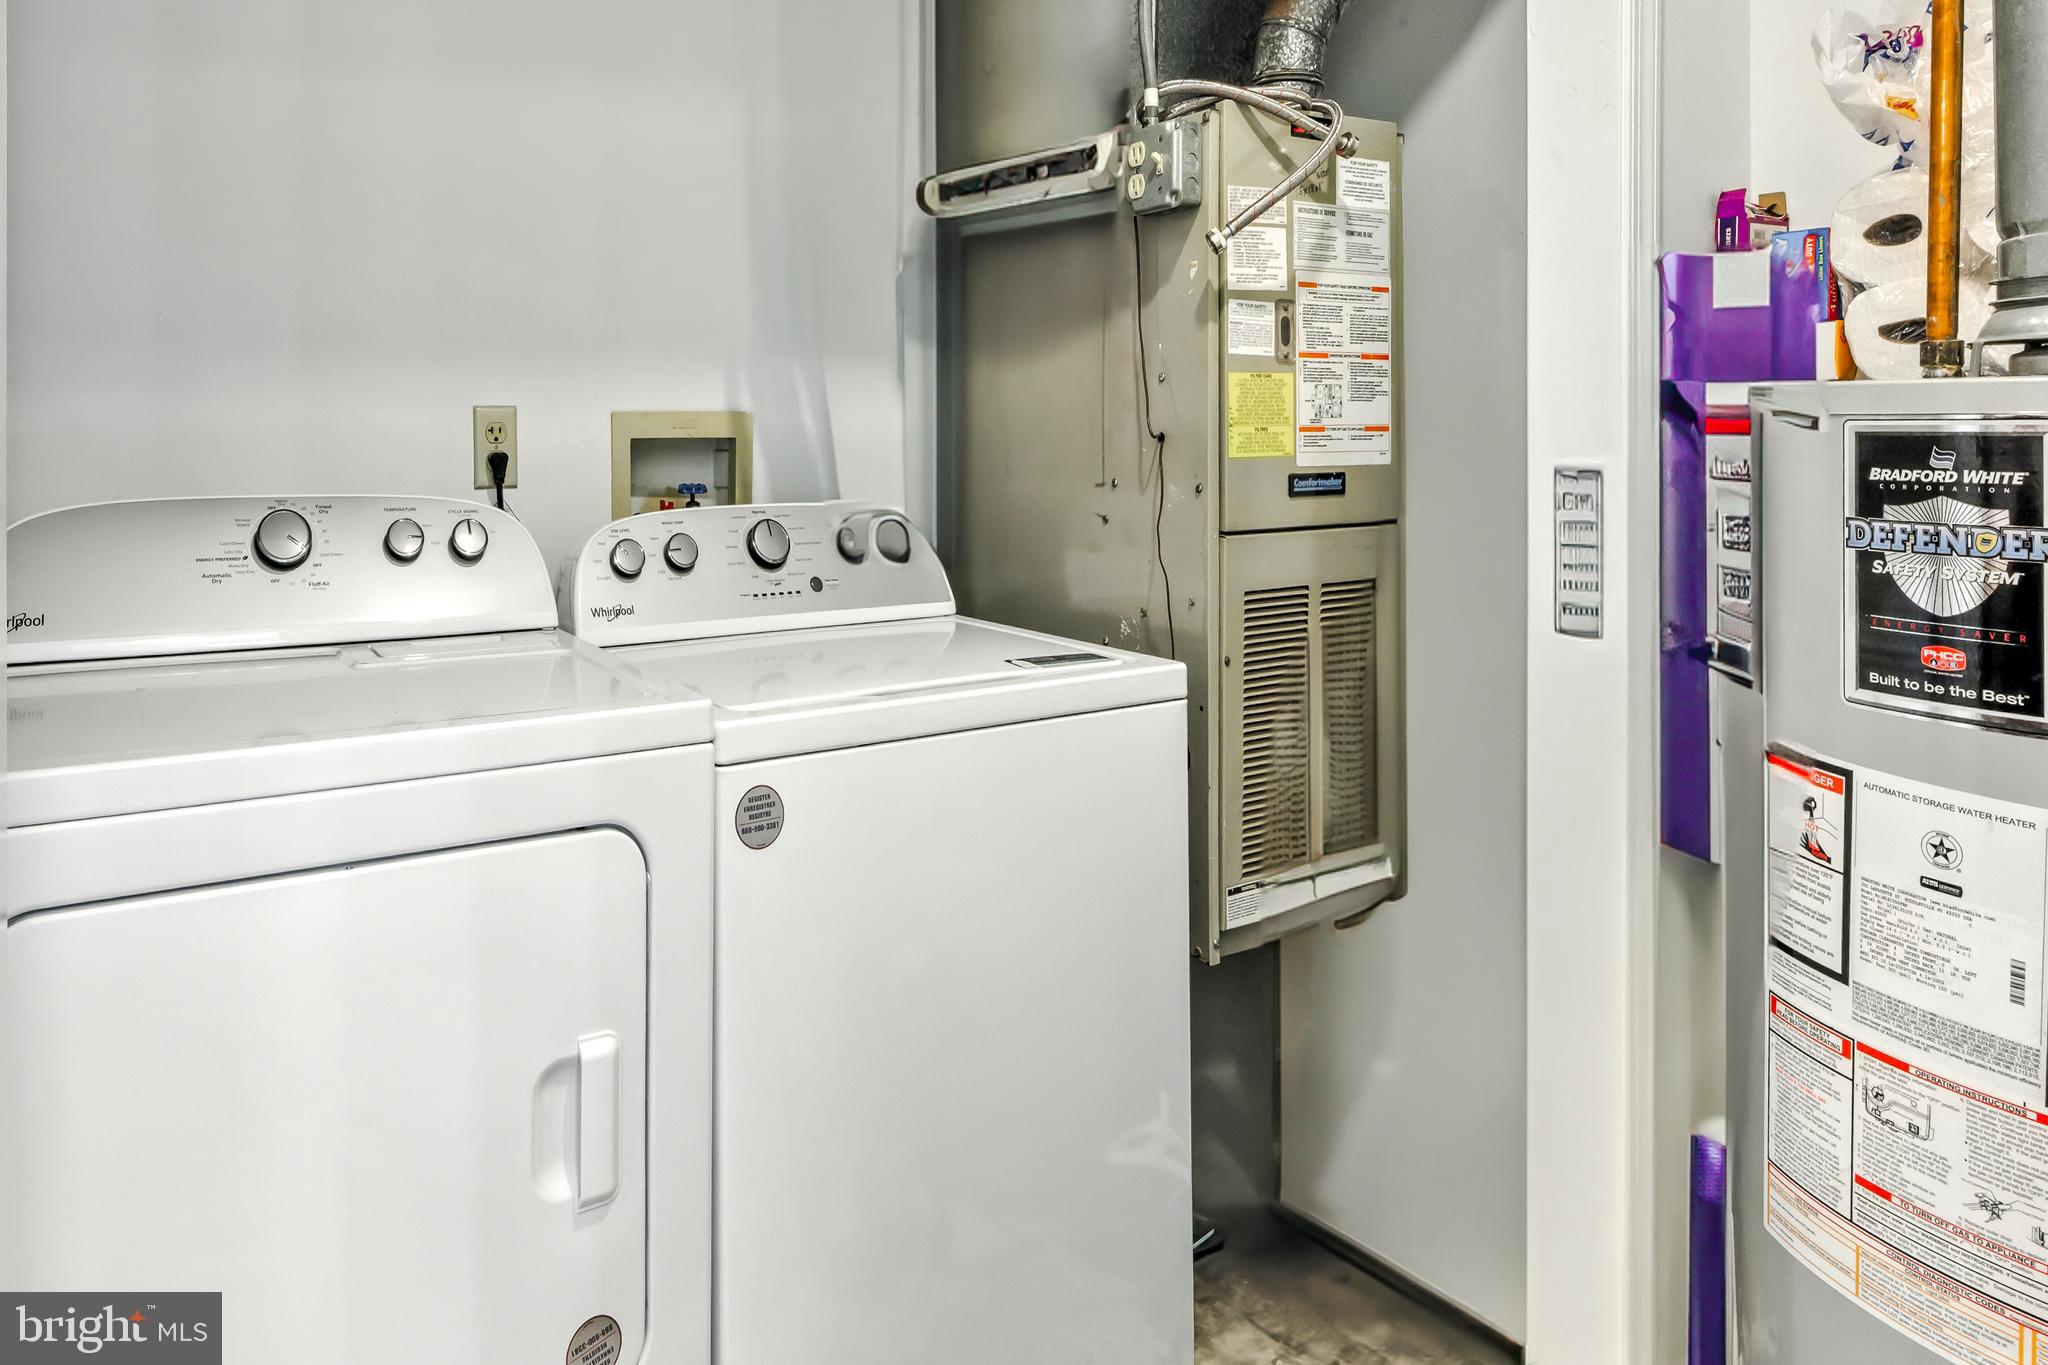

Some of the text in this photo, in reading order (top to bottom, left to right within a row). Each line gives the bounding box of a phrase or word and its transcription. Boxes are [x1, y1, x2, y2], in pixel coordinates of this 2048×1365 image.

[1294, 477, 1342, 488] Comfortmaker
[1869, 468, 1958, 484] BRADFORD
[1880, 484, 2010, 494] CORPORATION
[1872, 560, 1937, 580] SAFETY
[590, 604, 635, 622] Whirlpool
[1872, 616, 2027, 643] ENERGY SAVER
[1924, 649, 1964, 661] PHCC
[1870, 672, 1900, 687] Built
[1904, 678, 1919, 690] to
[1925, 680, 1945, 694] be
[1949, 684, 1977, 698] the
[748, 794, 771, 803] REGISTER
[1863, 782, 2036, 830] AUTOMATIC STORAGE WATER HEATER
[1804, 822, 1820, 832] HOT
[1777, 1009, 1840, 1051] READ BEFORE OPERATING
[1784, 1008, 1830, 1038] FOR YOUR SAFETY
[1914, 1069, 2028, 1117] OPERATING INSTRUCTIONS
[1900, 1200, 2036, 1267] TO TURN OFF GAS TO APPLIANCE
[1886, 1249, 2006, 1315] CONTROL DIAGNOSTIC CODES
[1904, 1269, 1960, 1300] CONTROL STATUS
